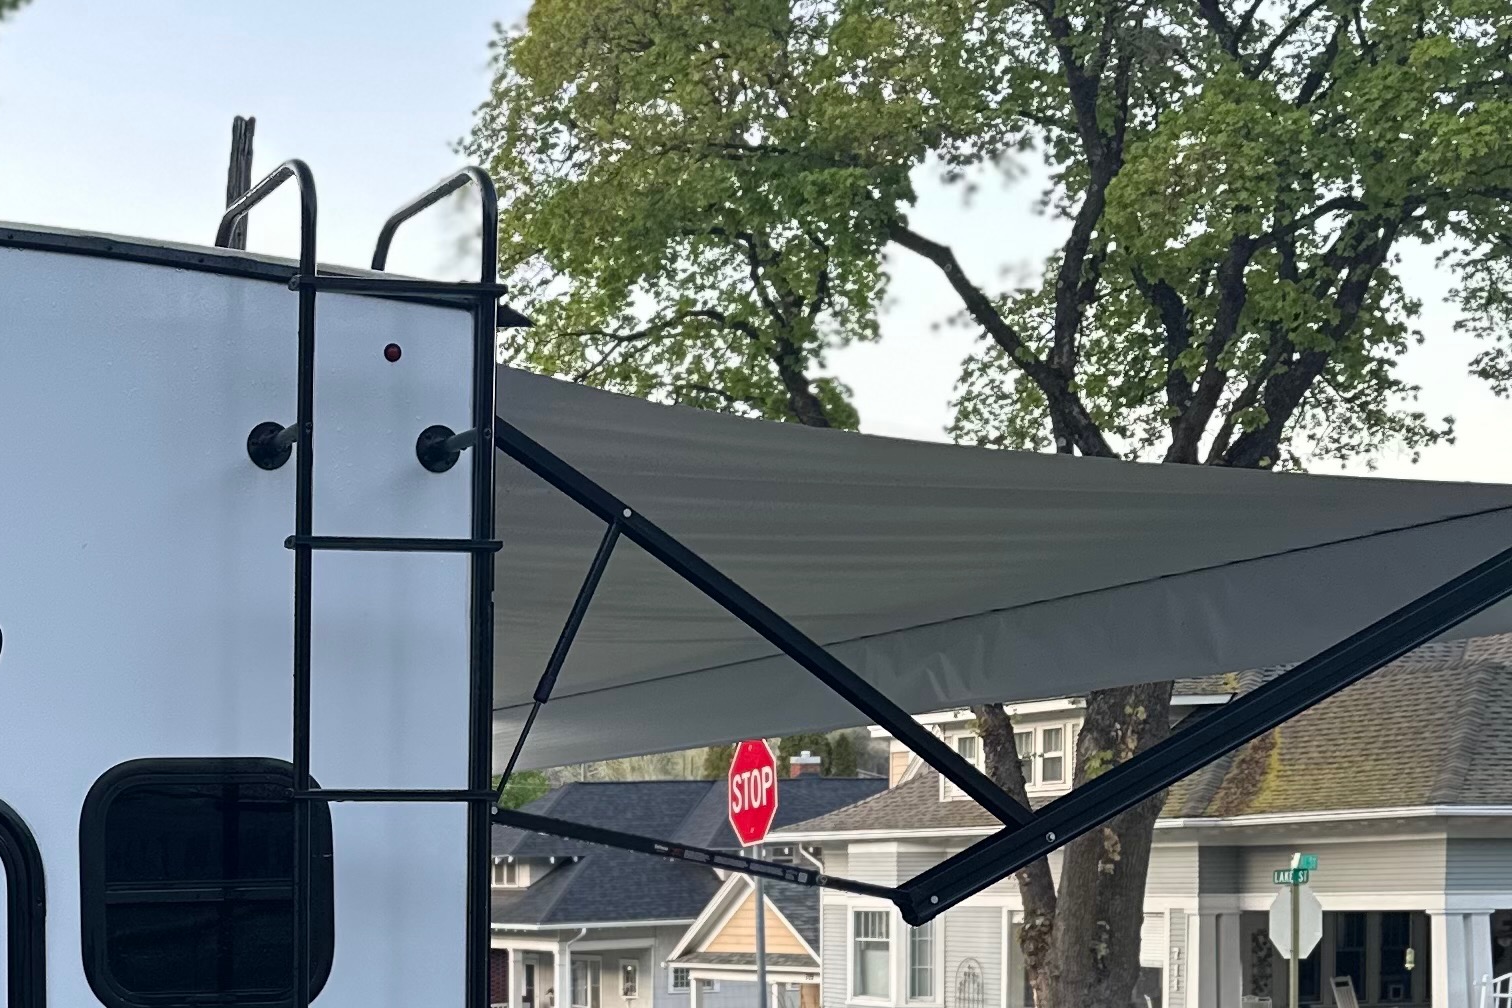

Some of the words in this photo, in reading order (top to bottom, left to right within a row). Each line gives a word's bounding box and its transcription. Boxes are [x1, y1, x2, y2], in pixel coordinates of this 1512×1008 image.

[731, 765, 773, 814] STOP
[1274, 871, 1294, 884] LAKE
[1298, 870, 1308, 883] ST
